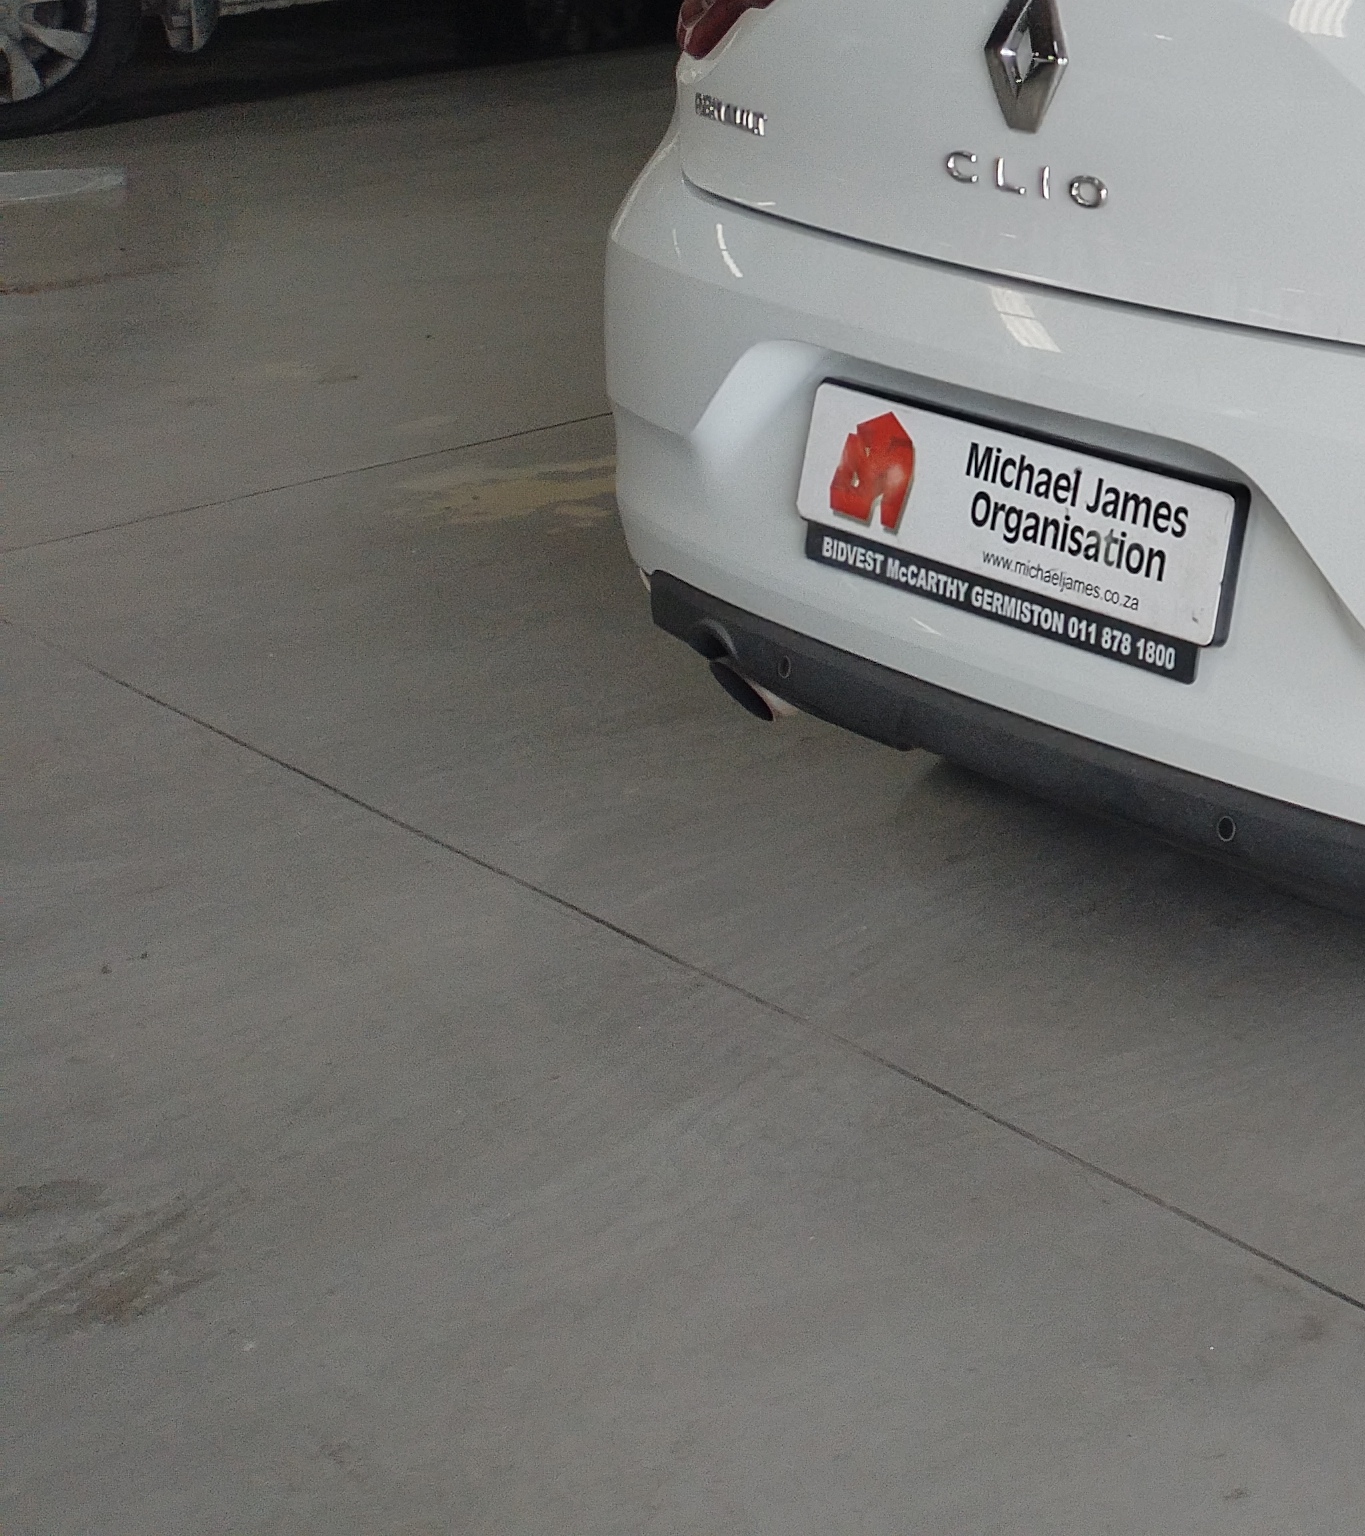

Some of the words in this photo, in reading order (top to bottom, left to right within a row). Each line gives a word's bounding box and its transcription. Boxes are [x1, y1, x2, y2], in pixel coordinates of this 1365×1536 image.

[944, 149, 1109, 210] CLIO
[965, 441, 1083, 507] Michael
[1086, 477, 1190, 539] James
[970, 490, 1167, 582] Organisation
[821, 535, 885, 575] BIDVEST
[886, 557, 969, 603] McCARTHY
[970, 584, 1065, 635] GERMISTON
[1067, 616, 1098, 645] 011
[1101, 625, 1132, 657] 878
[1136, 636, 1176, 671] 1800
[981, 549, 1140, 611] www.michaeljames.co.za
